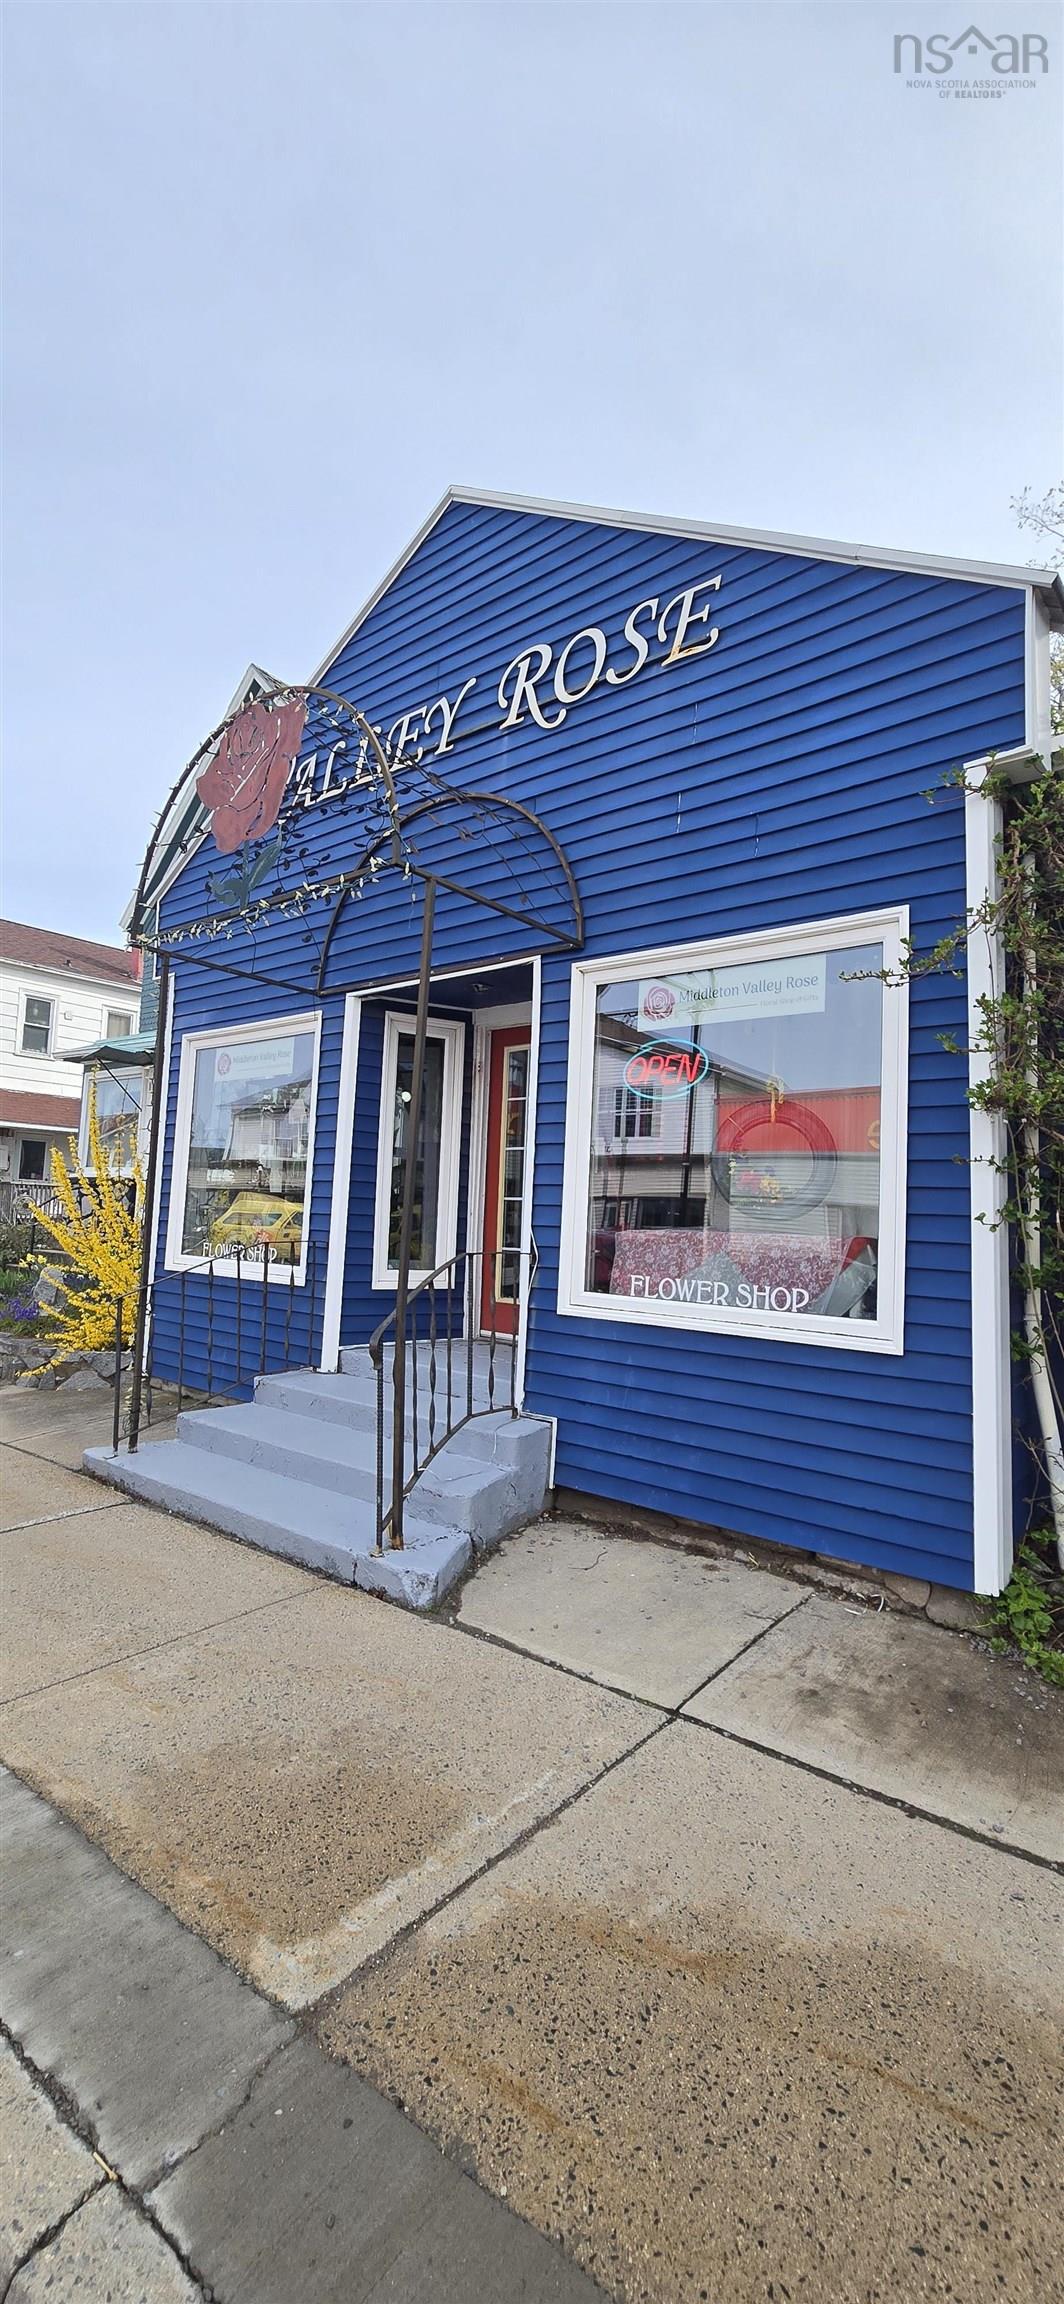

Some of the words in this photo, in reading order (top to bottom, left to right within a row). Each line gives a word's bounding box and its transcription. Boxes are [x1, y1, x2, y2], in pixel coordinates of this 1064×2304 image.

[497, 573, 723, 730] ROSE
[679, 987, 739, 1004] Middleton
[742, 978, 782, 995] Valley
[786, 975, 819, 990] Rose
[627, 1053, 701, 1086] OPEN
[202, 1242, 246, 1261] FLOWER
[629, 1274, 730, 1306] FLOWER
[735, 1283, 810, 1313] SHOP
